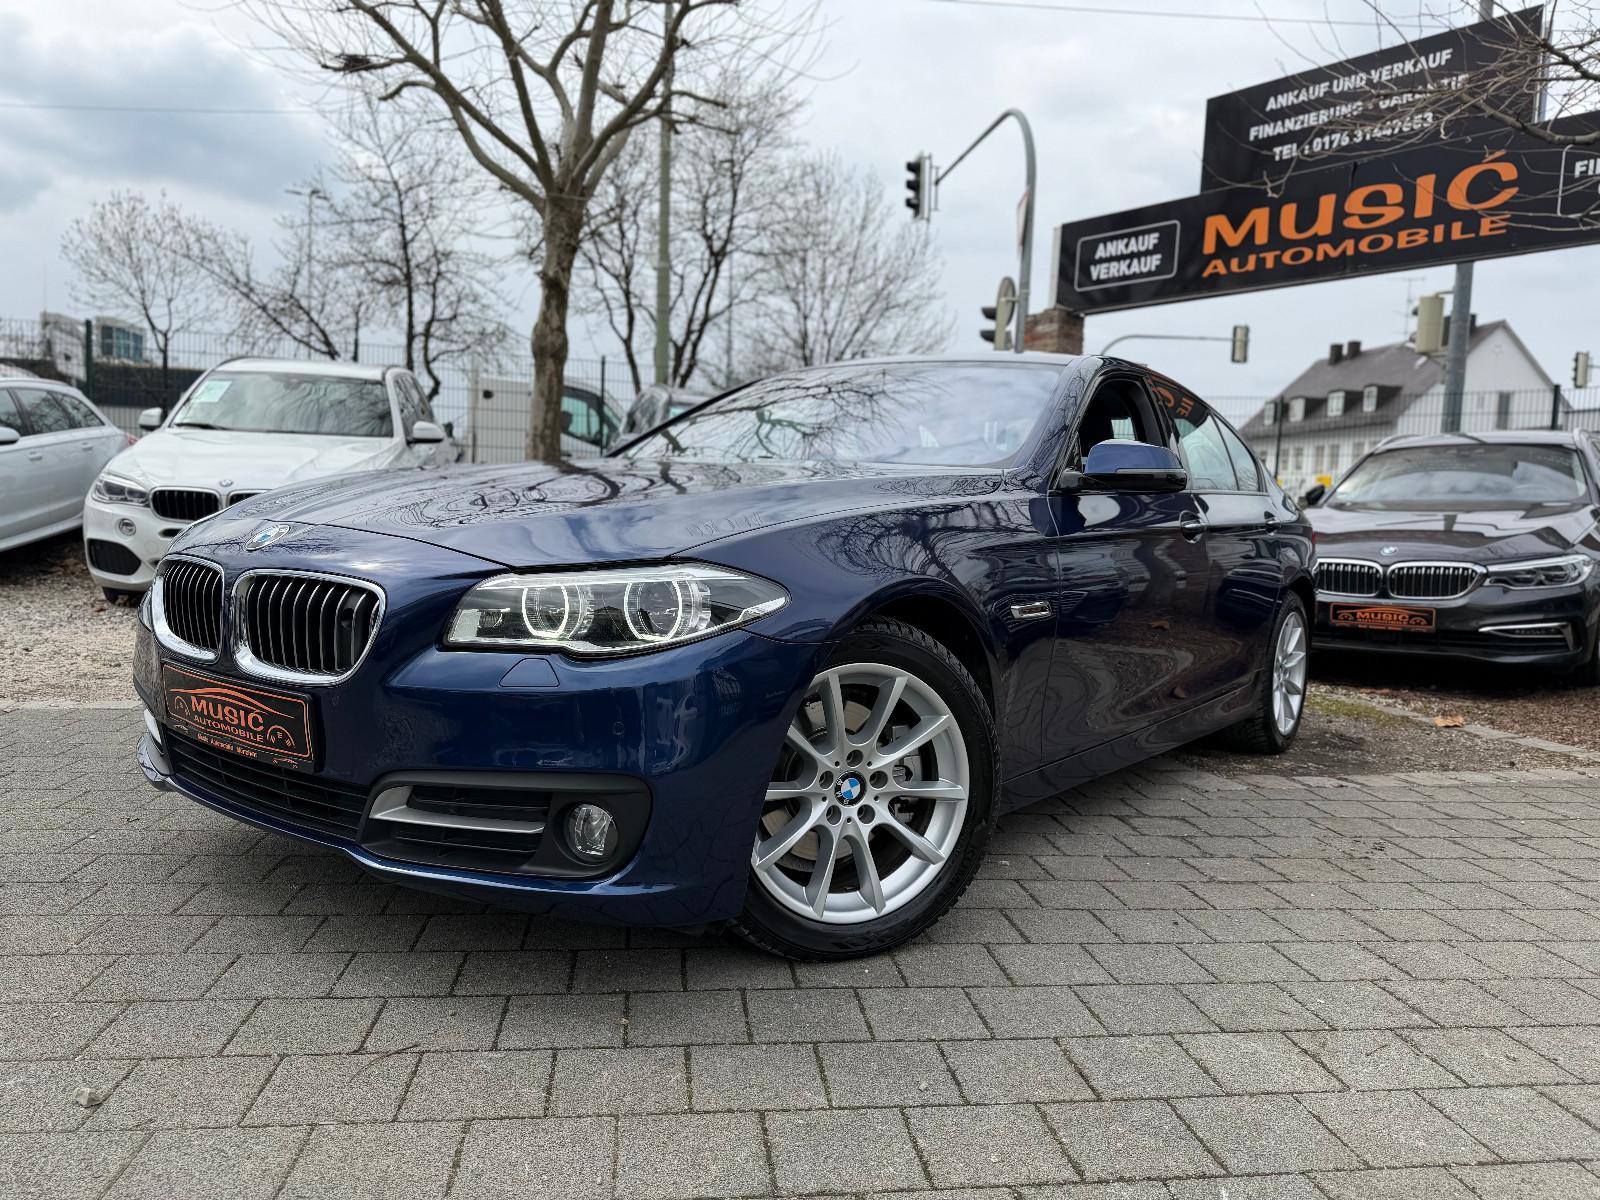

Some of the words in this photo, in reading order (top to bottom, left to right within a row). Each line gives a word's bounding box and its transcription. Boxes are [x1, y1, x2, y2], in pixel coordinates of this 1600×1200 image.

[1265, 81, 1330, 112] ANKAUF
[1333, 73, 1367, 94] UND
[1370, 48, 1453, 84] VERKAUF
[1273, 142, 1300, 161] TEL
[1312, 130, 1350, 151] 0176
[1202, 150, 1520, 255] MUSIĆ
[1094, 232, 1160, 260] ANKAUF
[1201, 213, 1512, 278] AUTOMOBILE
[1089, 253, 1162, 281] VERKAUF
[193, 715, 264, 743] AUTOMOBILE
